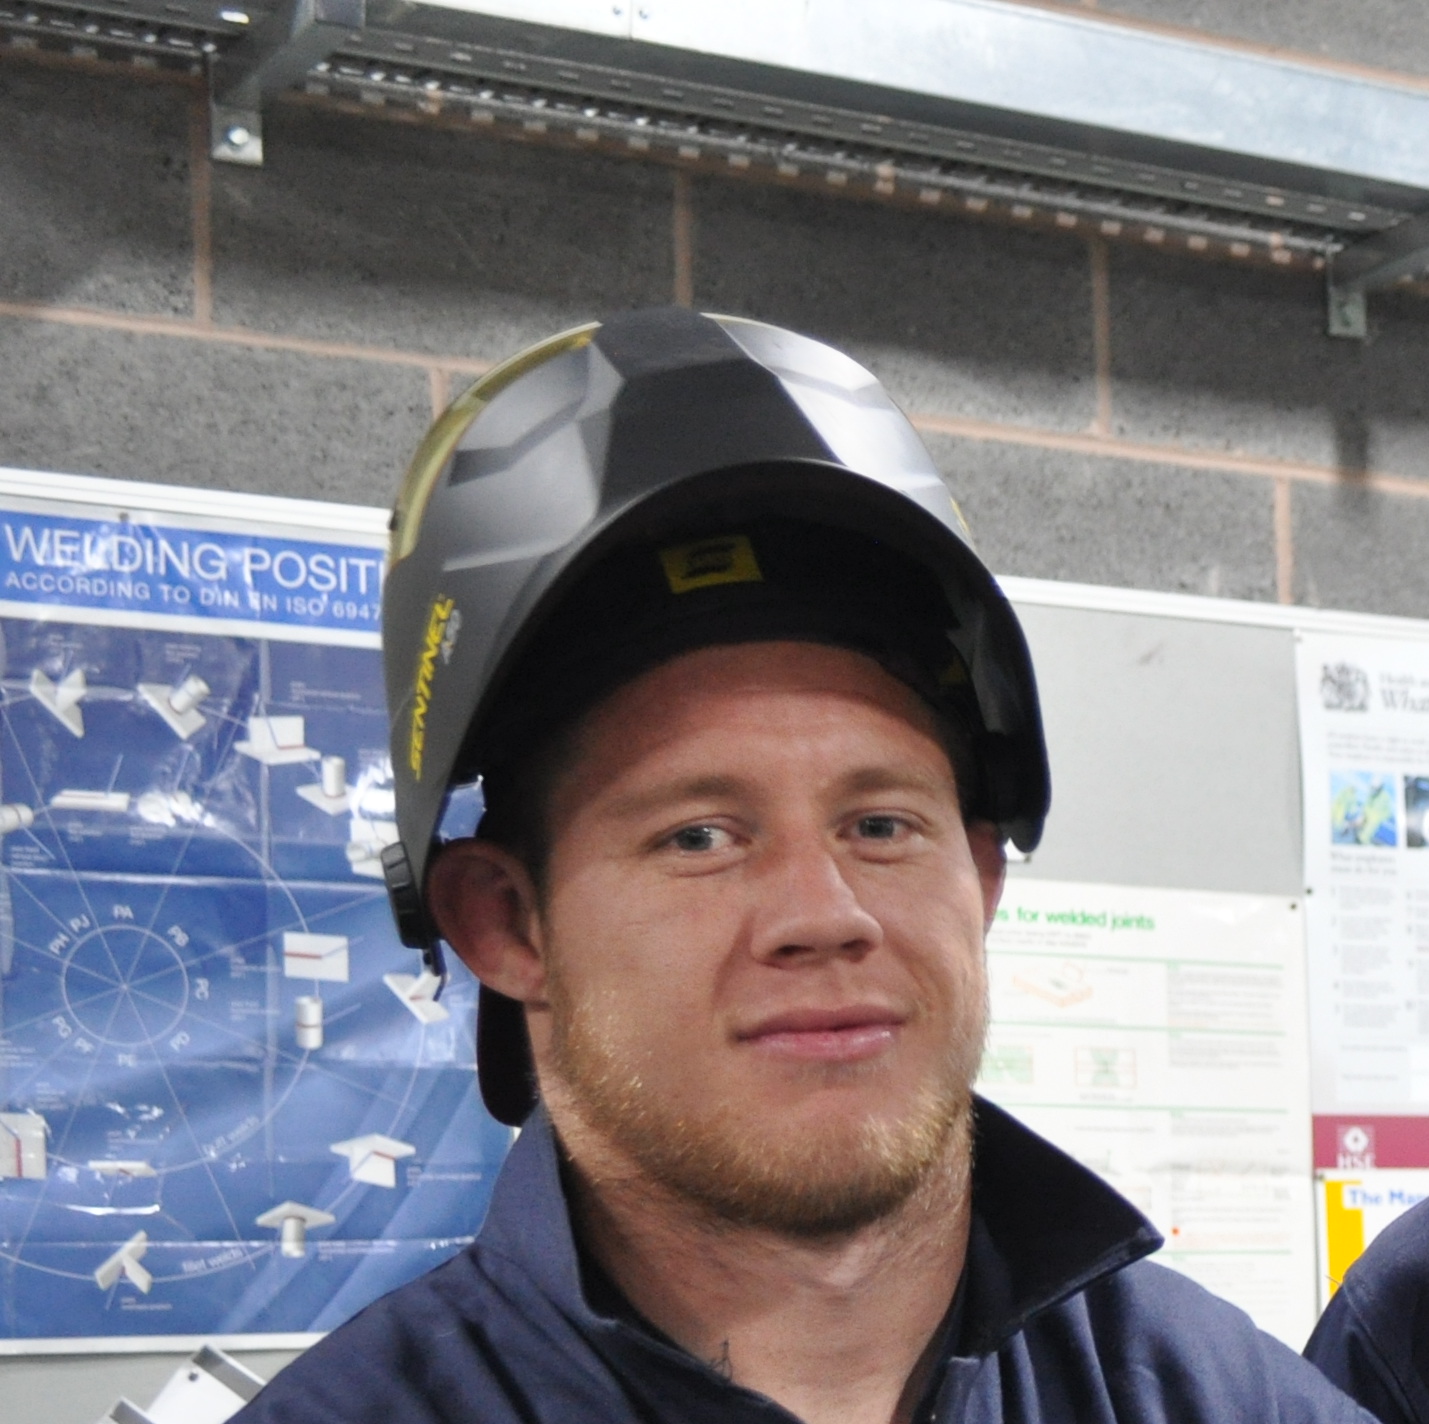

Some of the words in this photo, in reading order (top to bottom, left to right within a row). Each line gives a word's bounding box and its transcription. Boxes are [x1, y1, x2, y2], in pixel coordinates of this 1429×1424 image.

[5, 523, 227, 581] WELDING
[5, 570, 151, 601] ACCORDING
[159, 584, 191, 605] TO
[200, 586, 240, 609] DIN
[286, 595, 323, 617] ISO
[69, 913, 91, 932] PJ
[113, 903, 135, 921] PA
[1016, 905, 1039, 922] for
[1045, 908, 1107, 928] welded
[1109, 910, 1155, 933] joints
[49, 932, 71, 956] PH
[1349, 1189, 1383, 1206] The
